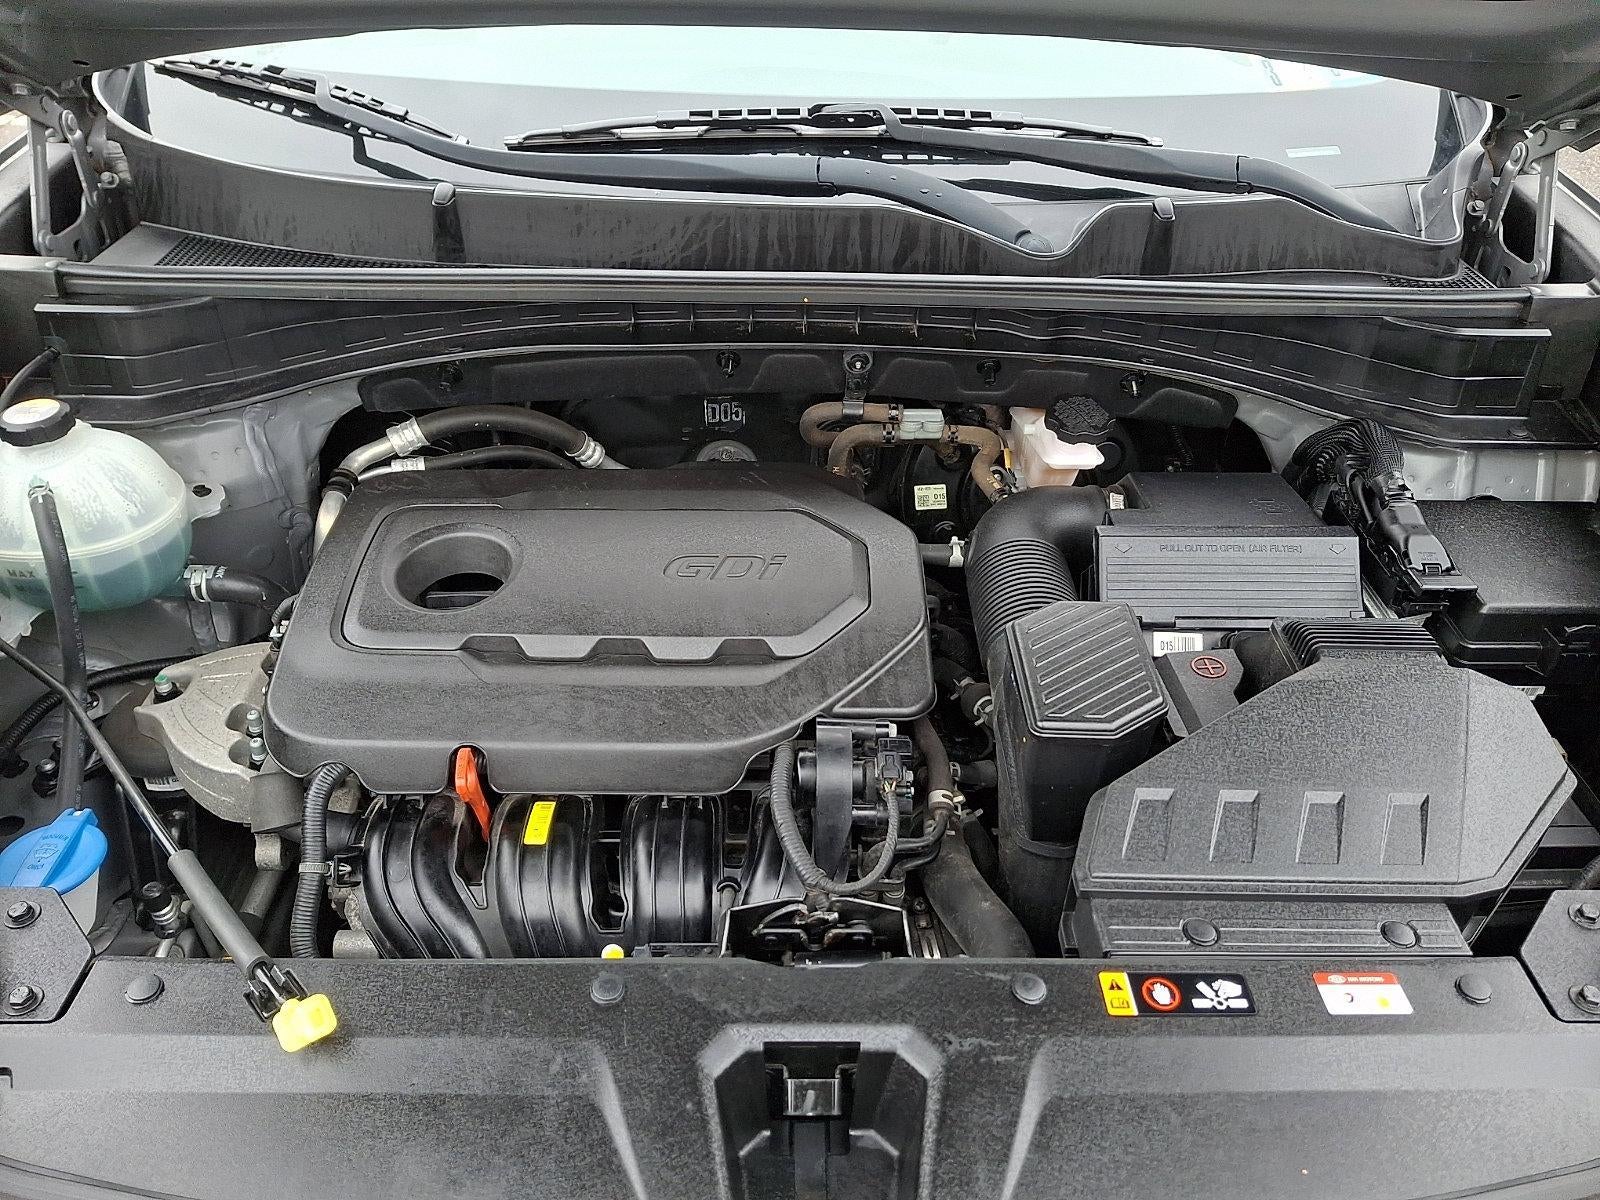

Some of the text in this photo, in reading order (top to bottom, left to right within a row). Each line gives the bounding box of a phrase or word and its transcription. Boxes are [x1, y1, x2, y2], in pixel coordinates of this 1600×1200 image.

[707, 402, 742, 422] D05
[1159, 544, 1184, 552] PULL
[1185, 544, 1204, 552] OUT
[1206, 544, 1218, 552] TO
[1219, 544, 1245, 552] OPEN
[7, 569, 35, 578] MAX
